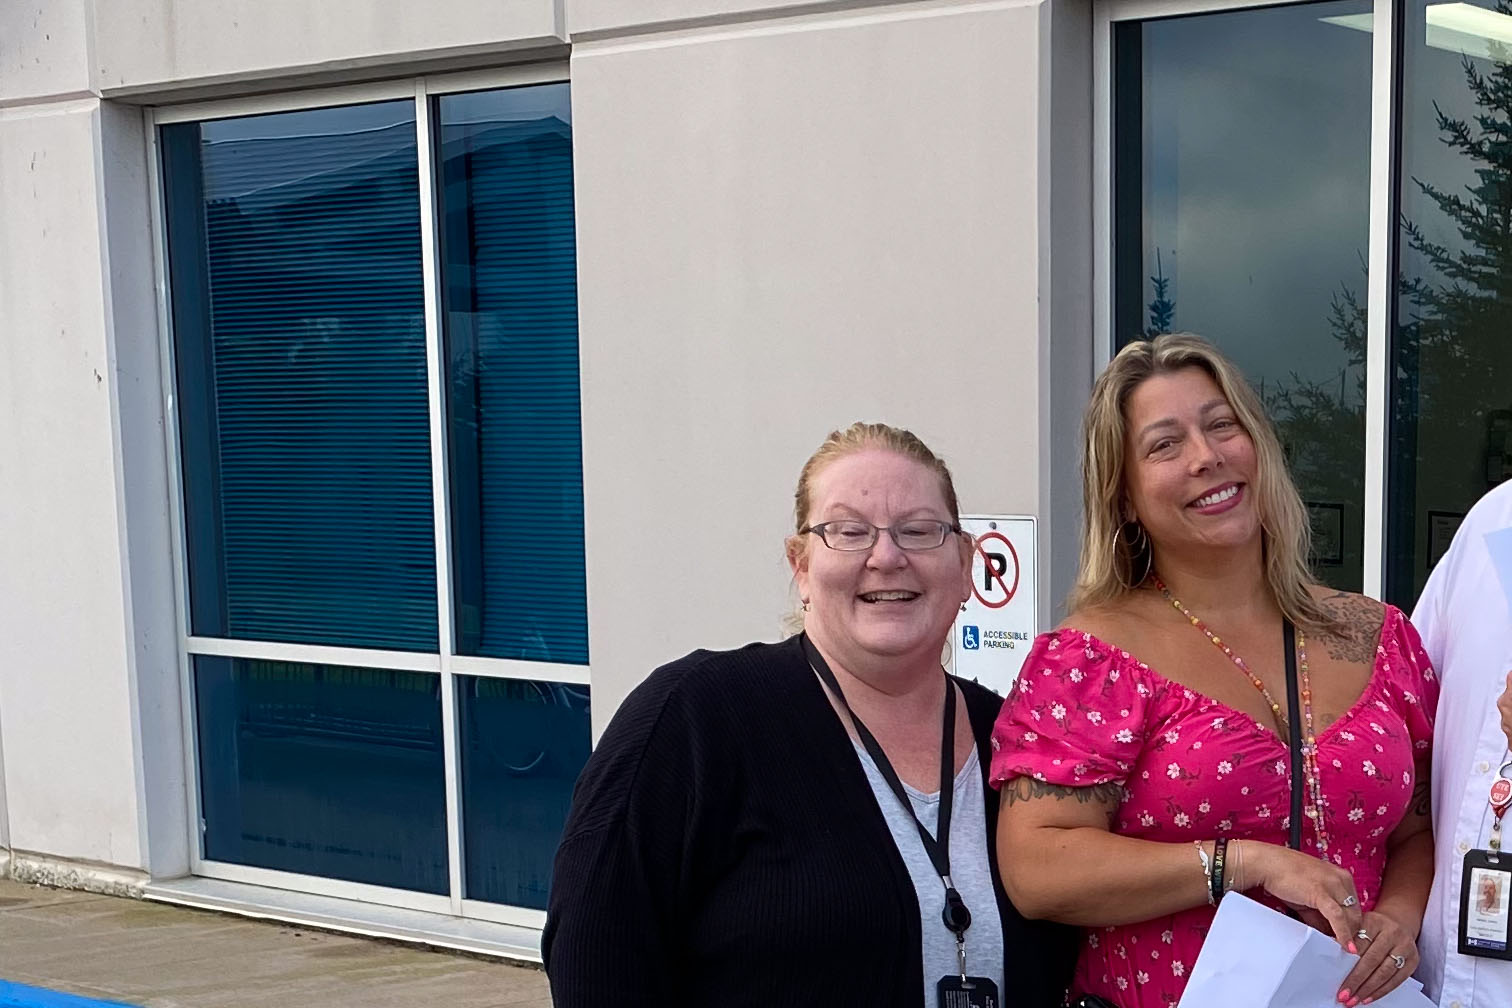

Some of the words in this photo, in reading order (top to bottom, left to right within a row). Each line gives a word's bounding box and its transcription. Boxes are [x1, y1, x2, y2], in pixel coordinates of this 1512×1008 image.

[985, 552, 1007, 591] P
[984, 630, 1028, 640] ACCESSIBLE
[983, 640, 1015, 649] PARKING
[1215, 845, 1225, 867] LOVE
